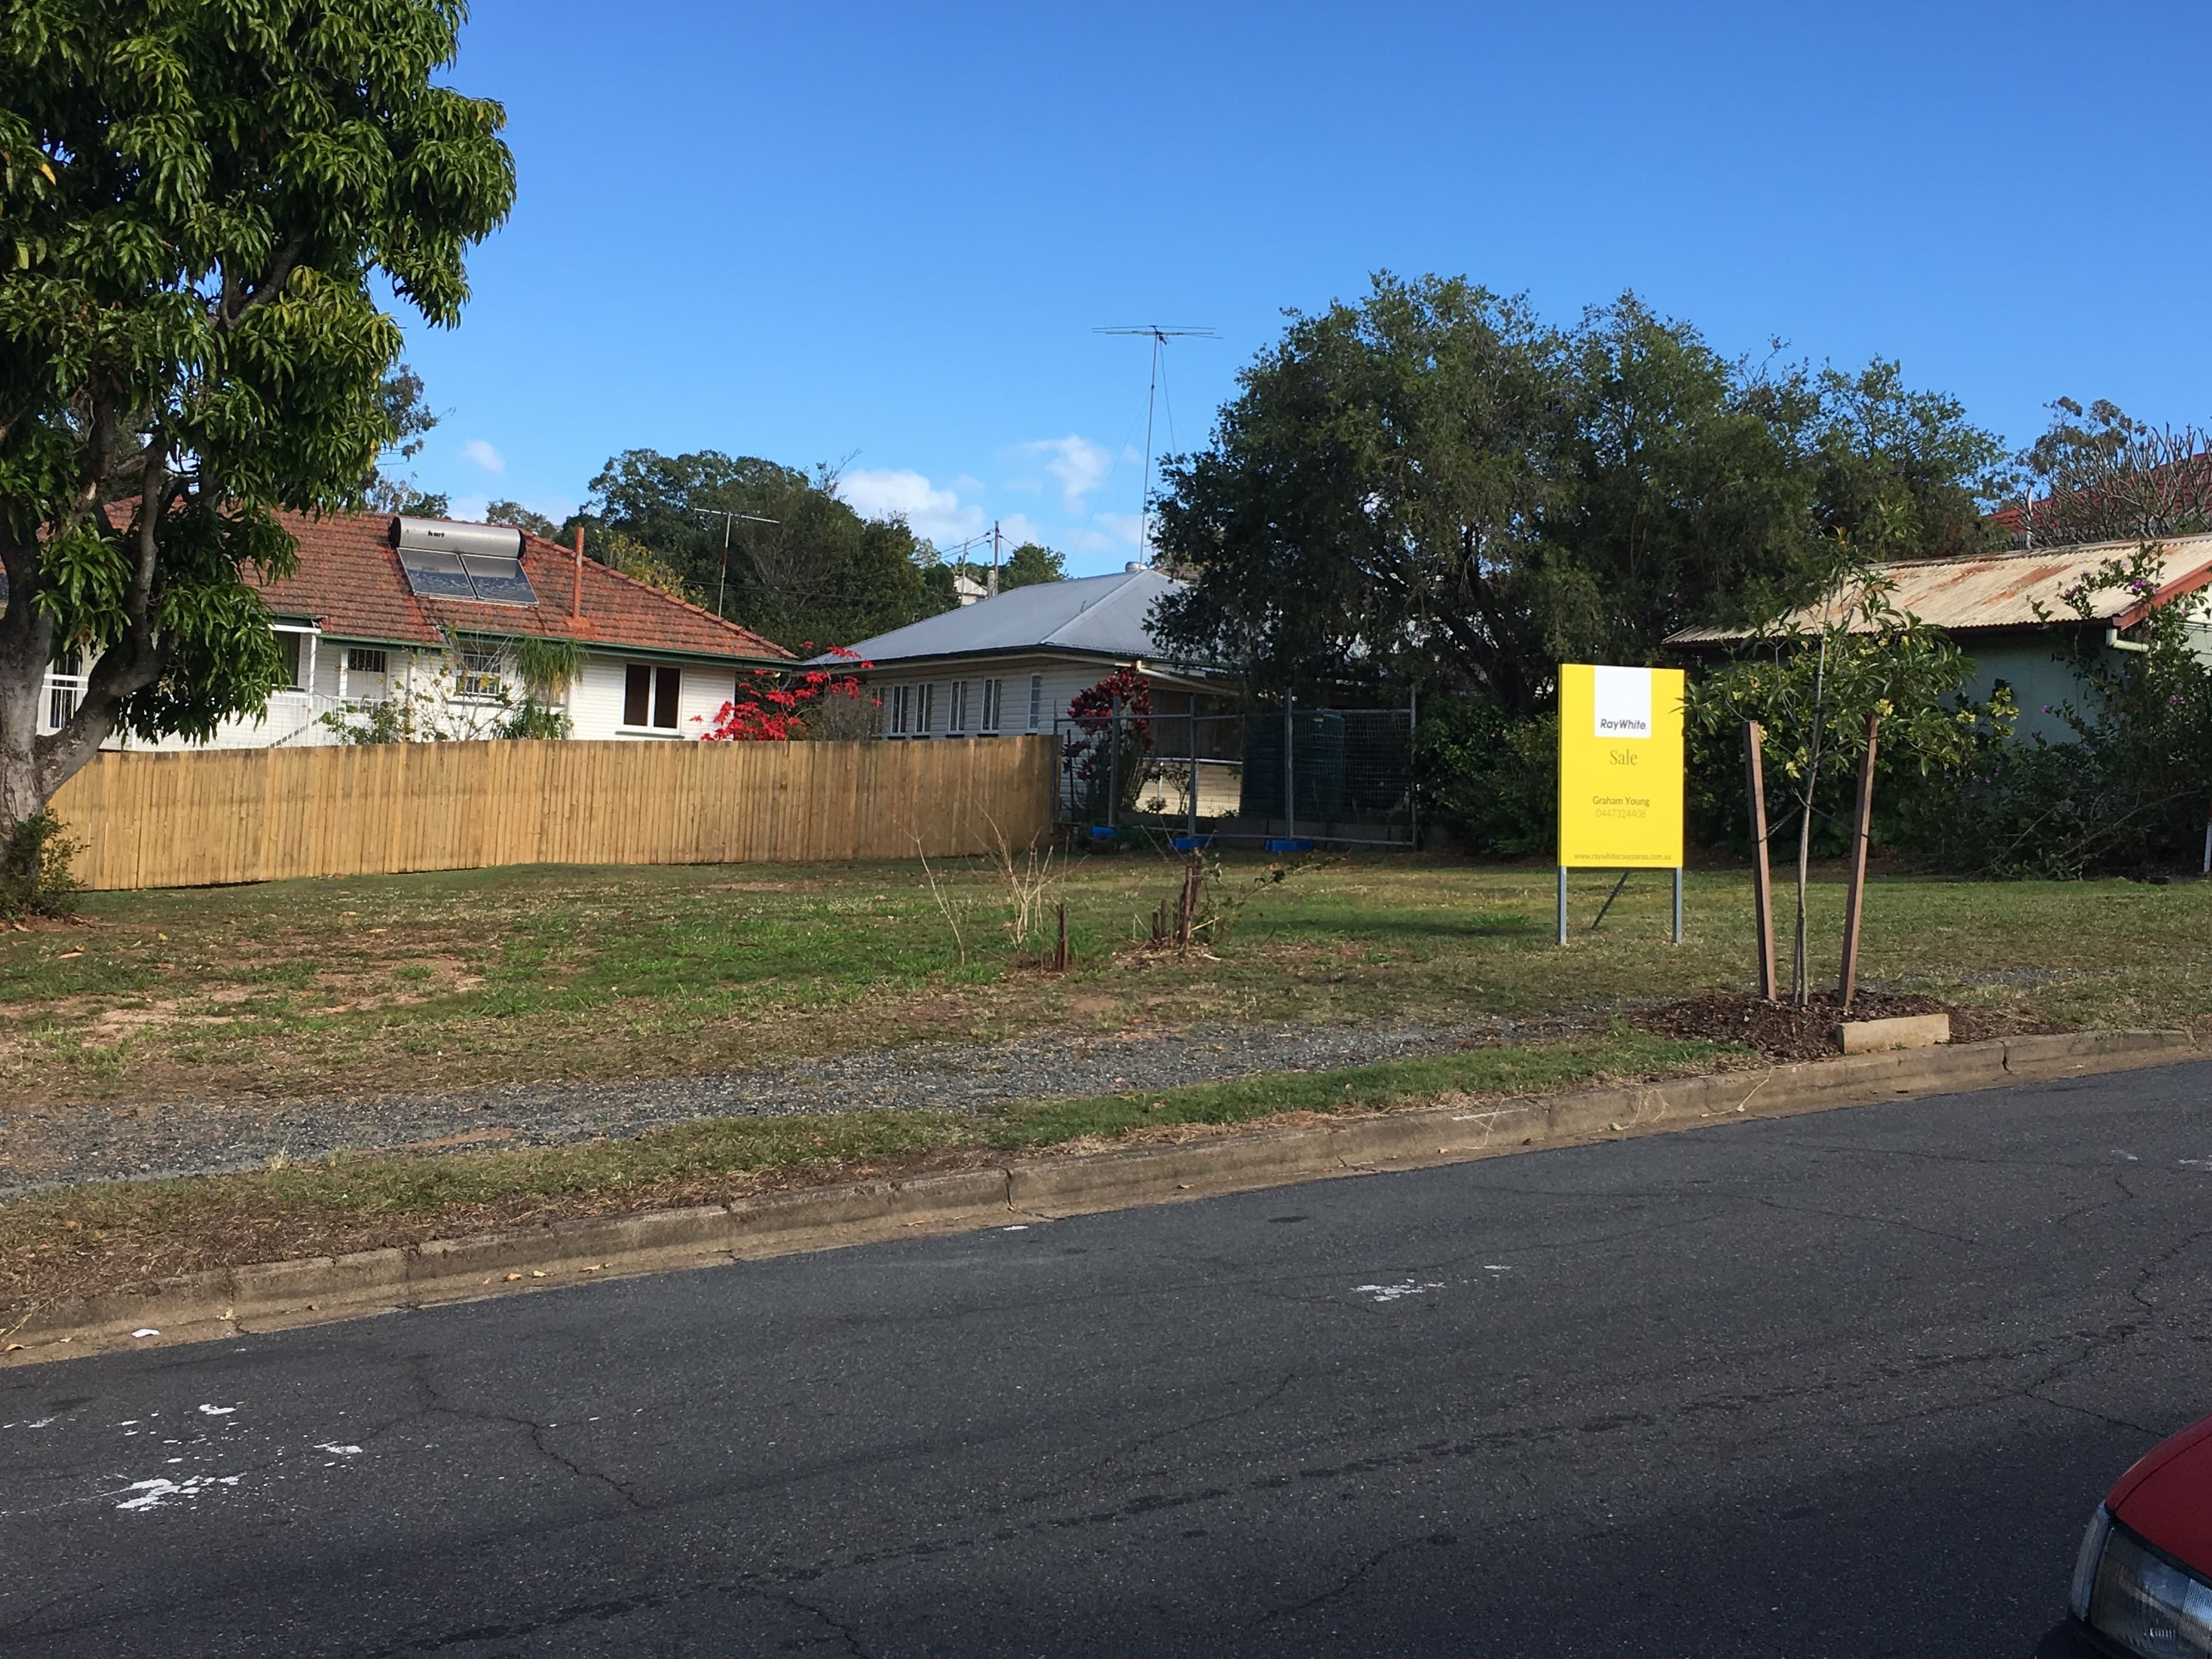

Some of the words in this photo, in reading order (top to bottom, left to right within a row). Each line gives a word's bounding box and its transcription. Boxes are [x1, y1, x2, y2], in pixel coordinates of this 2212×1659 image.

[1609, 749, 1638, 765] Sale
[1592, 796, 1623, 805] Graham
[1624, 797, 1650, 807] Young
